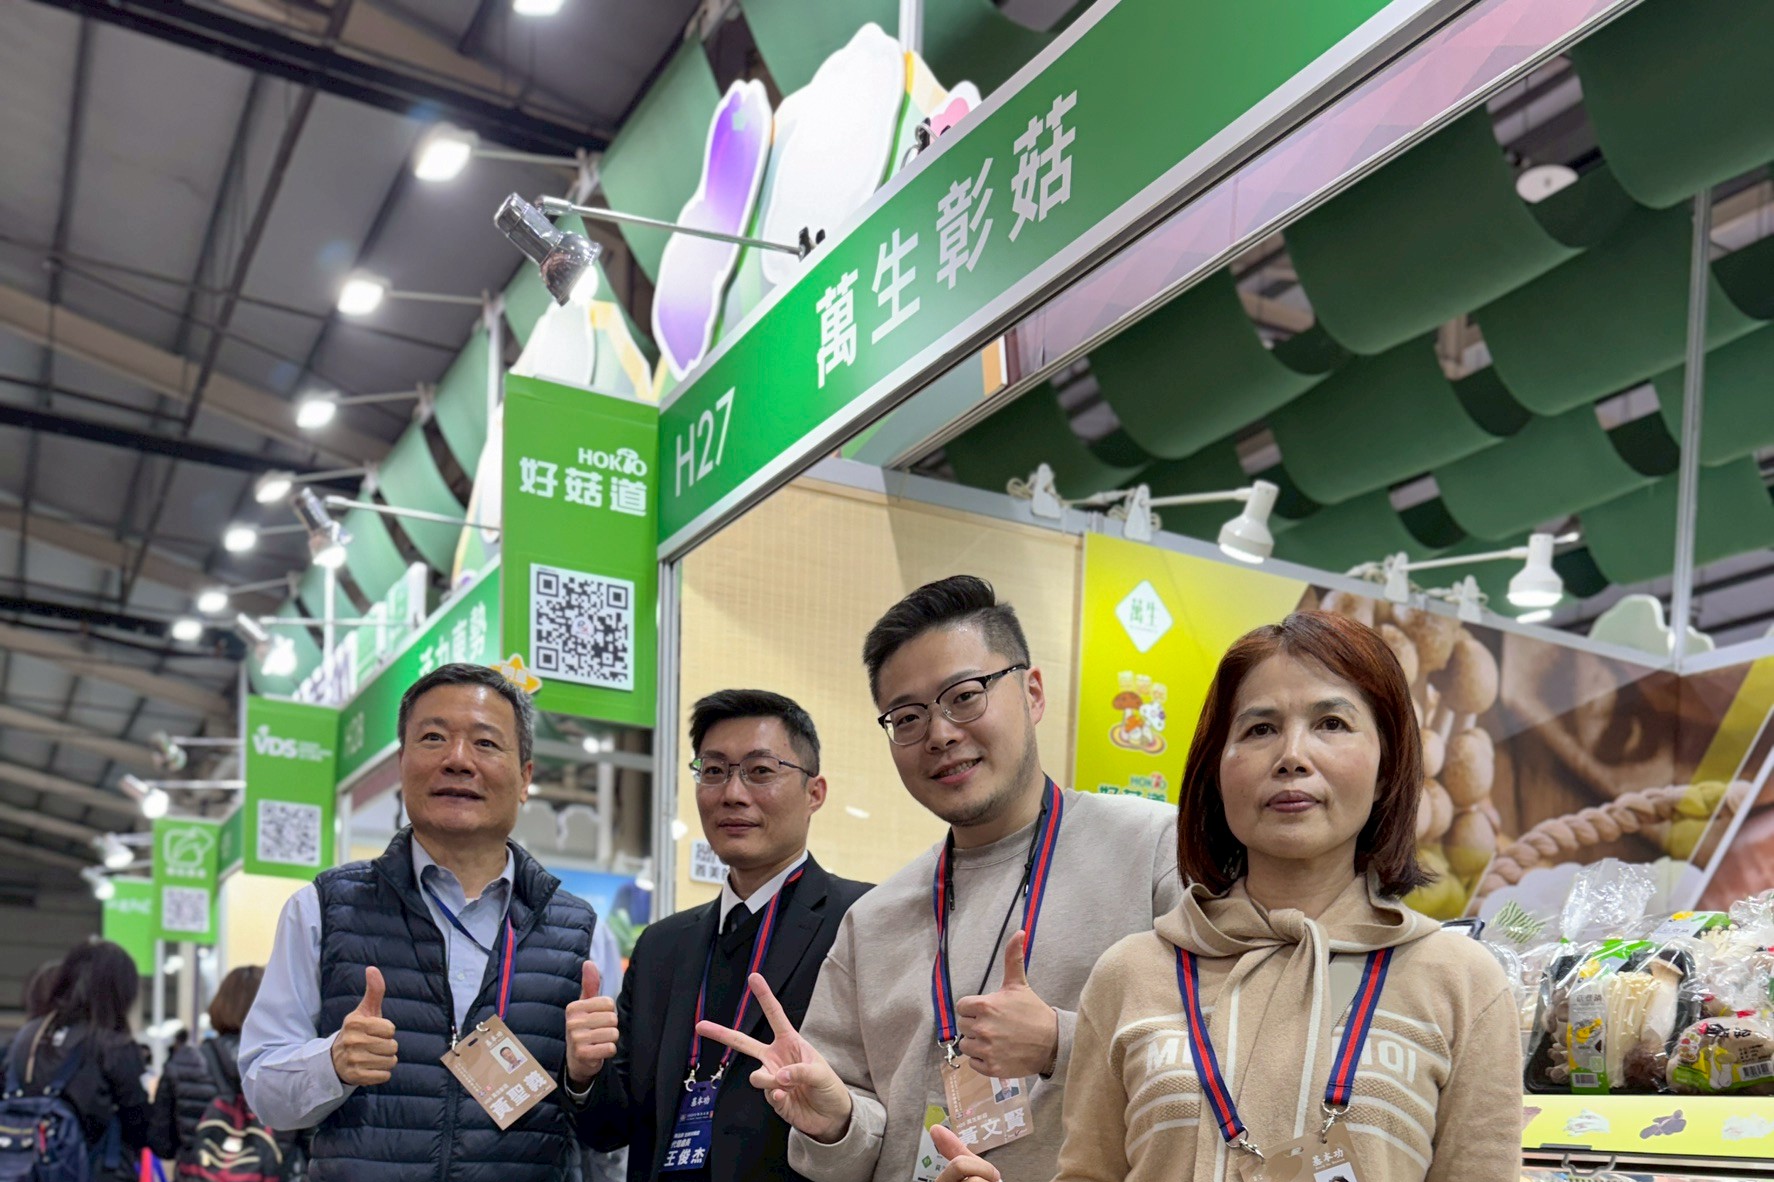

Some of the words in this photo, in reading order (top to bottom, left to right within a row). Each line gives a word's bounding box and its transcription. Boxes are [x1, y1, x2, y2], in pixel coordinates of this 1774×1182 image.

[815, 90, 1078, 388] 萬生彰菇
[675, 387, 736, 497] H27
[519, 456, 647, 517] 好菇道
[1312, 1148, 1344, 1167] 基本功
